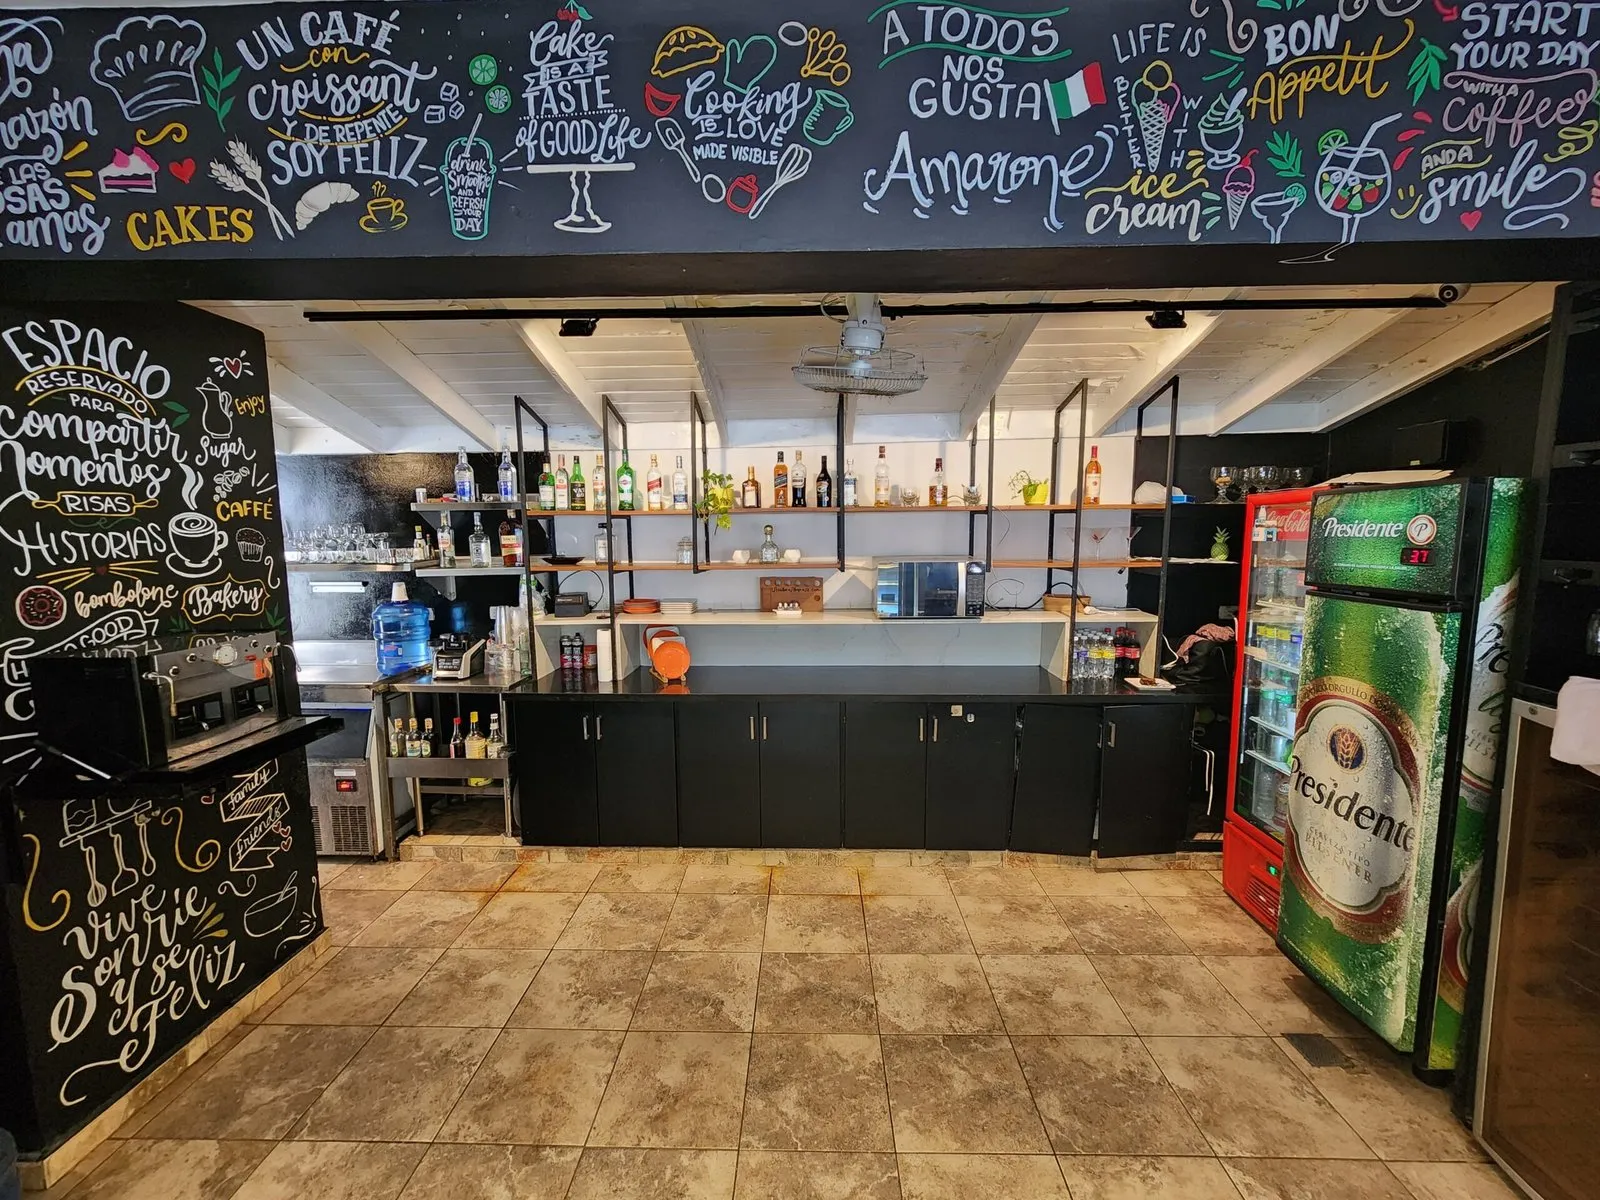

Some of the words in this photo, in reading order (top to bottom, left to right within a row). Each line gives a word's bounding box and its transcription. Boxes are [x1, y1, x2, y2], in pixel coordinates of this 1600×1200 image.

[236, 16, 295, 70] UN
[300, 9, 402, 55] CAFÉ
[883, 9, 910, 55] A
[917, 6, 1059, 56] TODOS
[1263, 13, 1340, 67] BON
[1462, 1, 1594, 39] START
[530, 19, 615, 67] Cake
[1112, 22, 1175, 64] LIFE
[1180, 27, 1206, 57] IS
[1450, 41, 1531, 71] YOUR
[1537, 39, 1600, 69] DAY
[546, 66, 562, 80] IS
[568, 62, 584, 76] A
[942, 56, 1004, 83] NOS
[1247, 28, 1410, 125] Appetit
[248, 60, 438, 121] croissant
[522, 75, 614, 117] TASTE
[684, 70, 811, 129] Cooking
[909, 77, 1041, 120] GUSTA
[282, 119, 298, 138] Y
[304, 124, 331, 144] DE
[333, 104, 405, 142] REPENTE
[516, 119, 538, 163] of
[540, 119, 598, 158] GOOD
[591, 114, 652, 164] Life
[699, 118, 717, 134] IS
[725, 118, 786, 147] LOVE
[1443, 89, 1584, 148] Coffee
[9, 162, 51, 185] LAS
[267, 139, 326, 186] SOY
[336, 135, 428, 188] FELIZ
[450, 154, 487, 173] drink
[693, 144, 726, 160] MADE
[730, 144, 778, 165] VISIBLE
[0, 178, 70, 214] SAS
[458, 188, 474, 196] AND
[863, 130, 1114, 230] Amarone
[1419, 139, 1562, 228] smile
[451, 195, 487, 211] REFRSH
[463, 208, 482, 218] YOUR
[1084, 195, 1201, 242] cream
[6, 203, 111, 255] amas
[126, 205, 255, 251] CAKES
[454, 217, 483, 232] DAY
[2, 319, 171, 399] ESPACIO
[25, 371, 148, 414] RESERVADO
[69, 392, 115, 413] PARA
[234, 394, 266, 417] Enjoy
[0, 404, 188, 463] Compartir
[195, 435, 256, 467] Sugar
[62, 494, 132, 514] RISAS
[216, 498, 274, 521] CAFFÉ
[1322, 517, 1404, 538] Presidente
[14, 521, 167, 577] HISTORIAS
[188, 581, 264, 617] Bakery
[80, 616, 134, 648] GOOD
[1329, 683, 1367, 700] ORGULLO
[1292, 755, 1415, 852] Presidente
